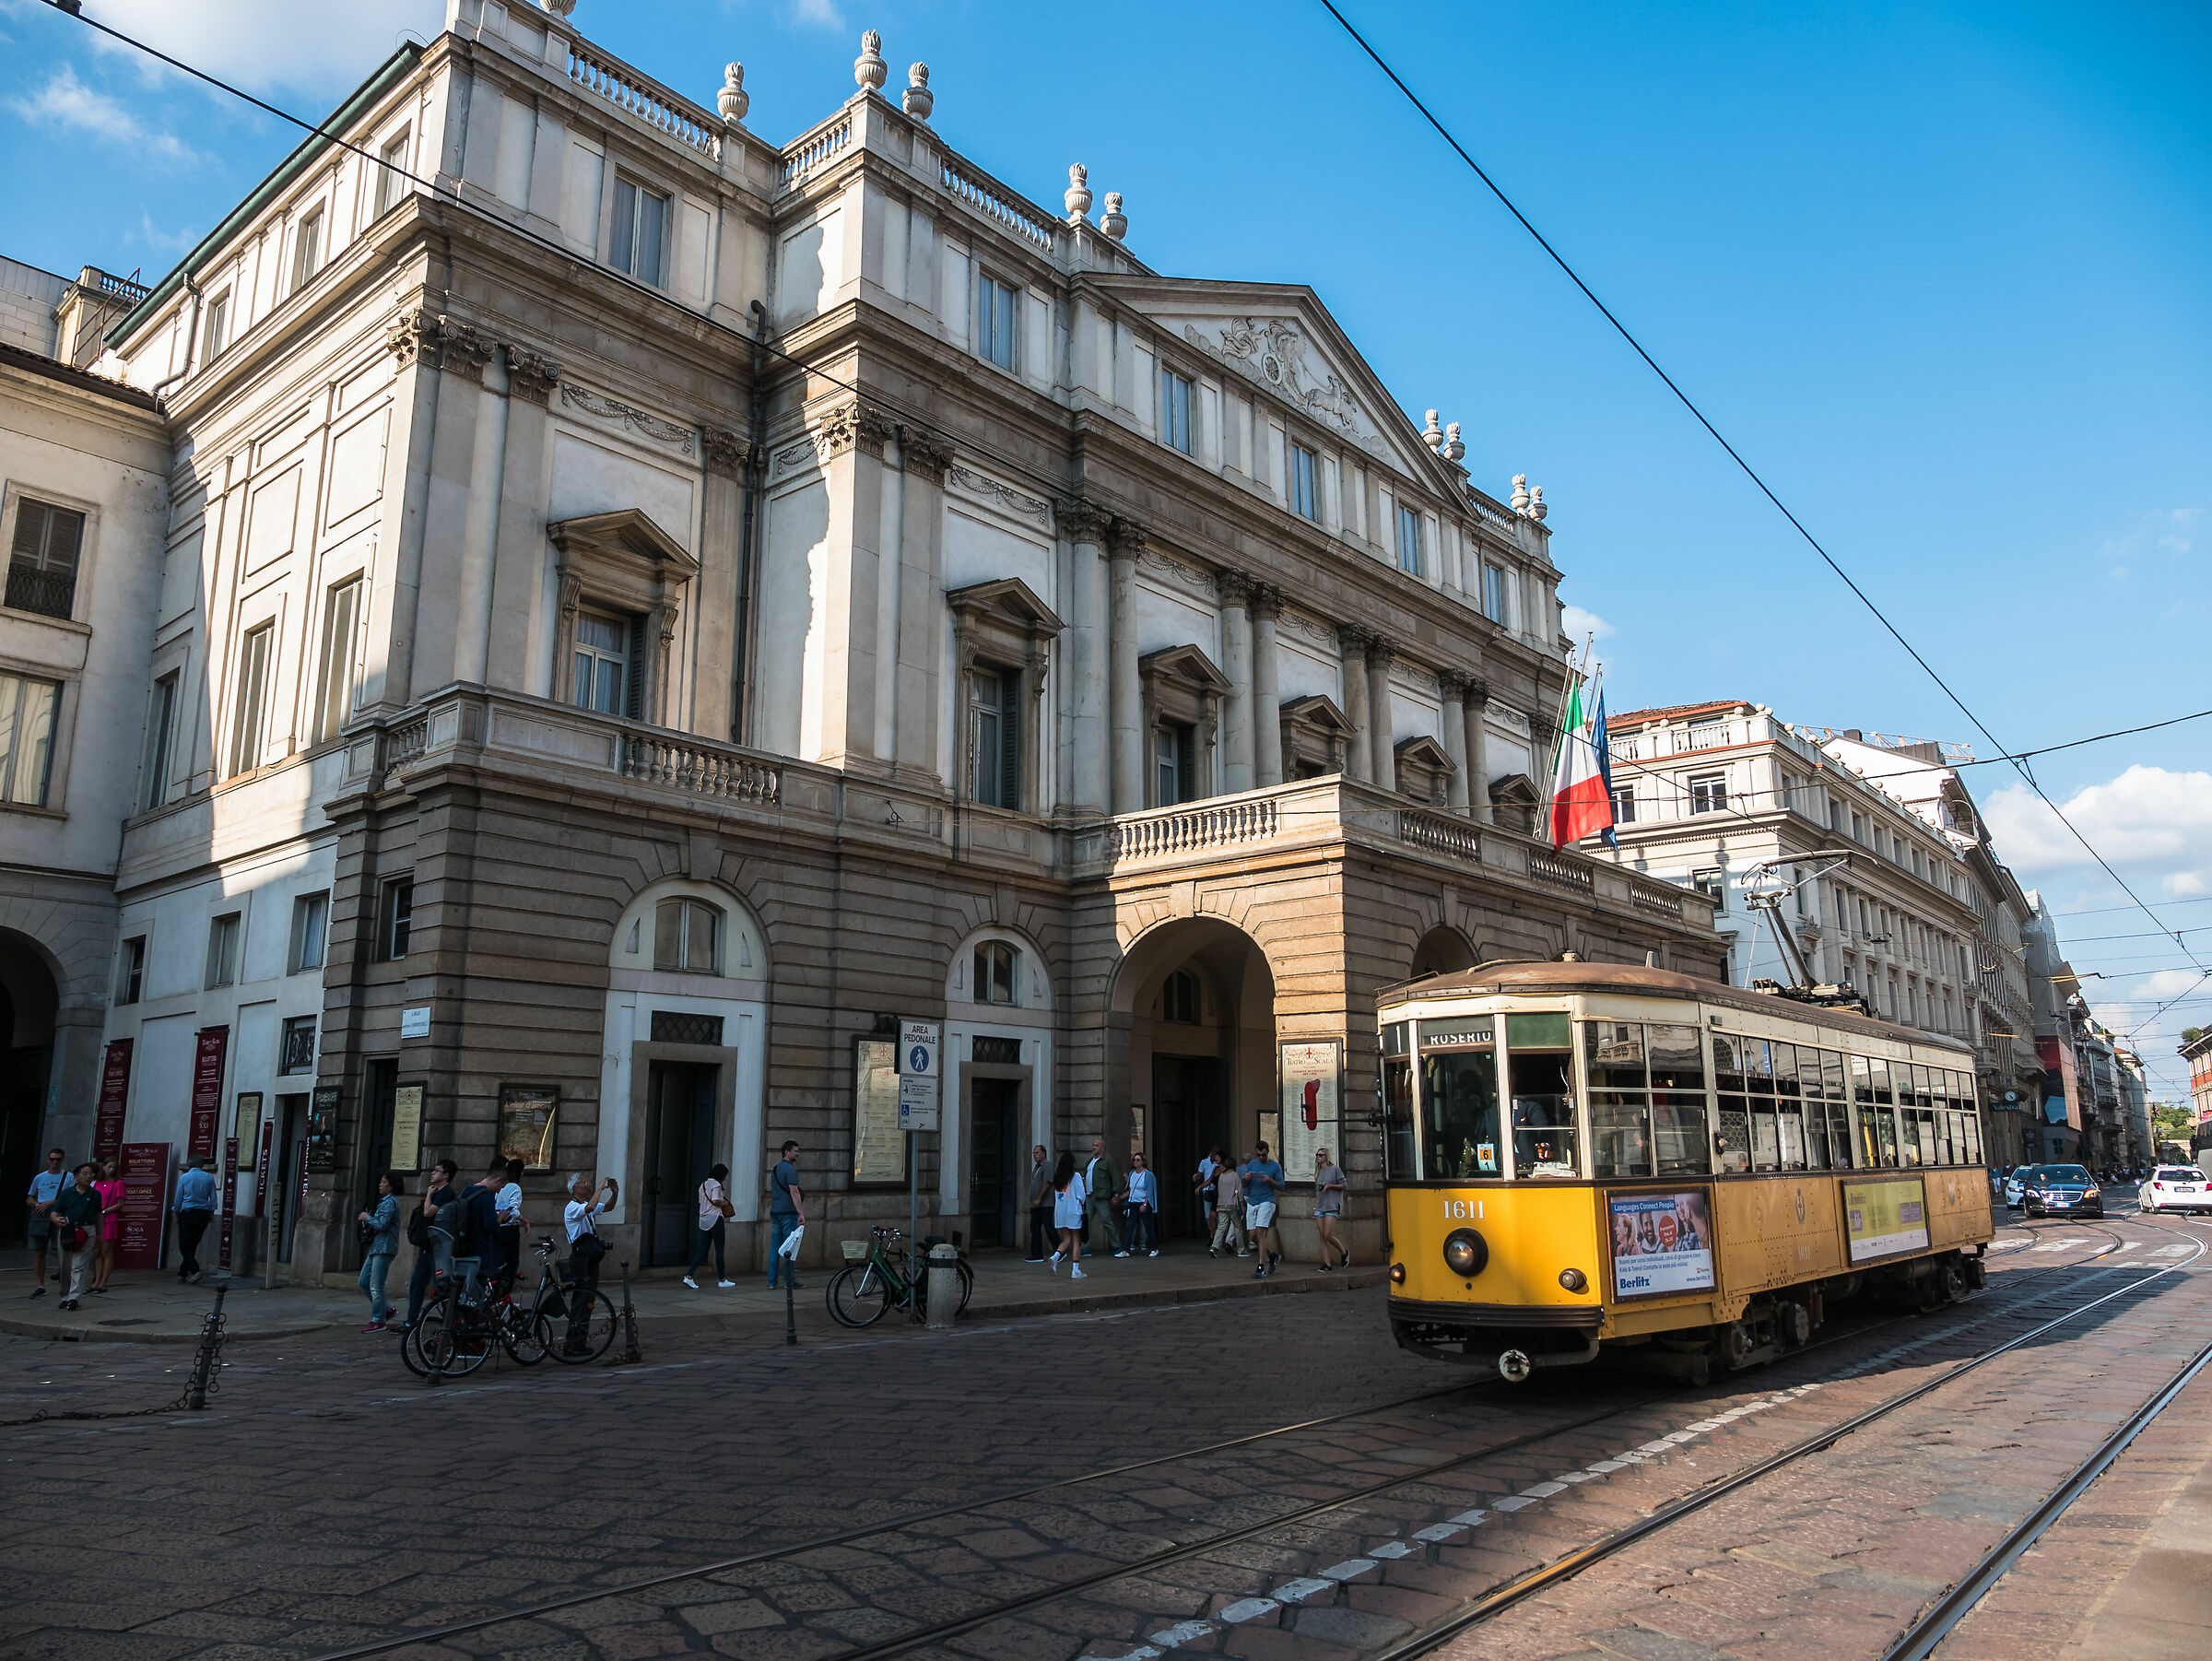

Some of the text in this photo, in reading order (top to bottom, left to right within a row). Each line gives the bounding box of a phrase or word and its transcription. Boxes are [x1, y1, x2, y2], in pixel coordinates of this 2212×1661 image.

[912, 1025, 928, 1034] AREA
[904, 1033, 936, 1044] PEDONALE
[1288, 1057, 1305, 1066] TEATRO
[1483, 1149, 1489, 1160] 6
[259, 1149, 268, 1196] TICKETS
[1443, 1200, 1484, 1219] 1611
[1614, 1201, 1675, 1212] Languages Connect People
[271, 1197, 279, 1246] SHOP
[1619, 1276, 1651, 1289] Berlitz
